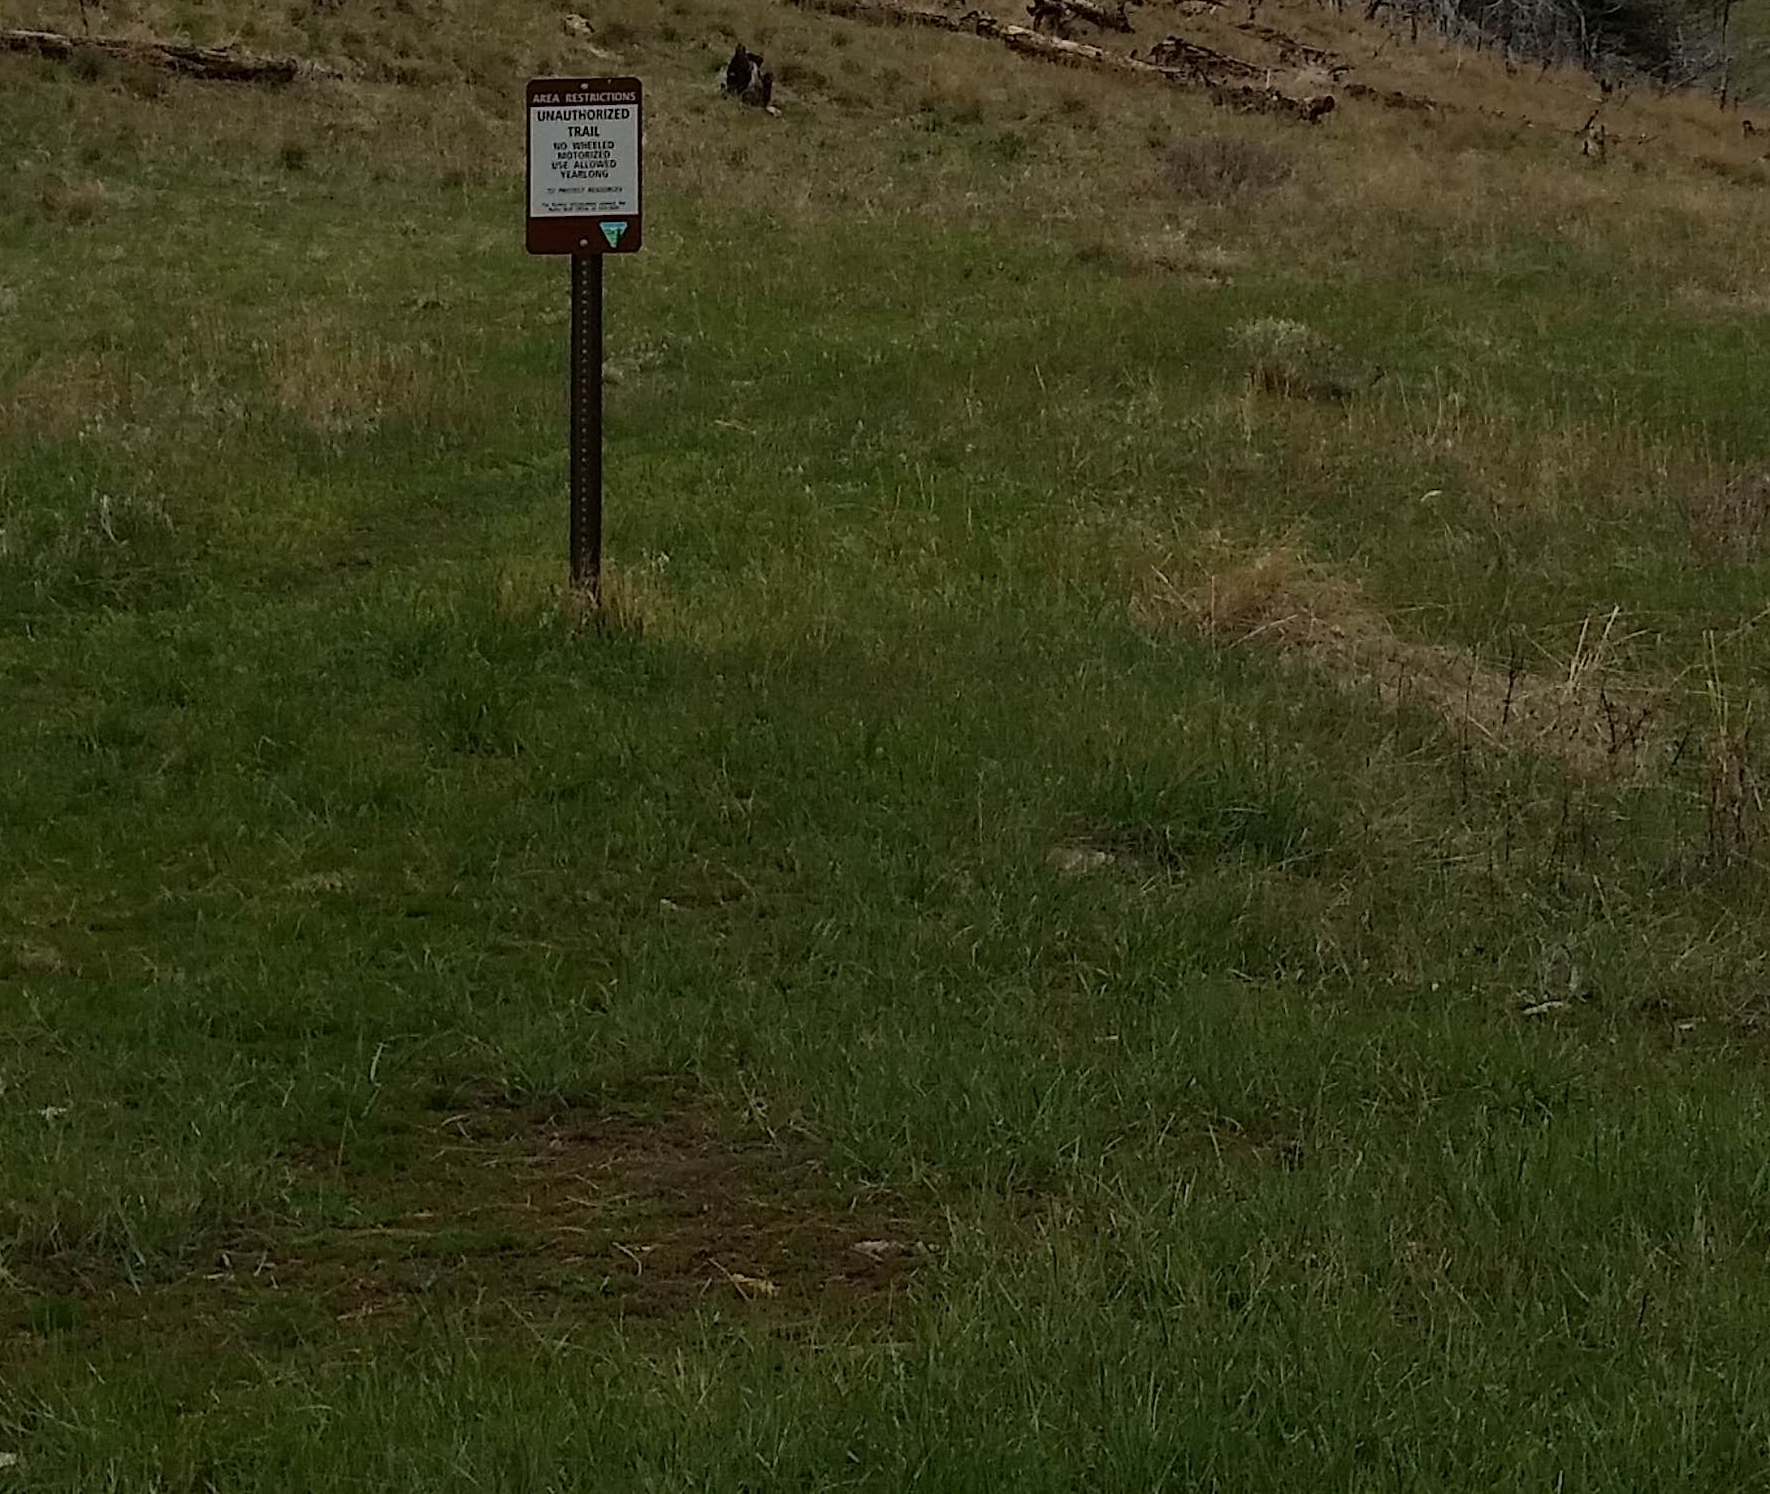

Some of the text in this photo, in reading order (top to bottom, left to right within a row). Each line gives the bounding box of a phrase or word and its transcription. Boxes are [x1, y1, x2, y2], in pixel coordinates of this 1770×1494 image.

[532, 92, 636, 103] AREA RESTRICTIONS
[537, 108, 630, 121] UNAUTHORIZED
[568, 126, 600, 137] TRAIL
[553, 141, 615, 150] NO WHEELED
[557, 151, 611, 160] MOTORIZED
[551, 160, 617, 170] USE ALLOWED
[560, 169, 609, 179] YEARLONG
